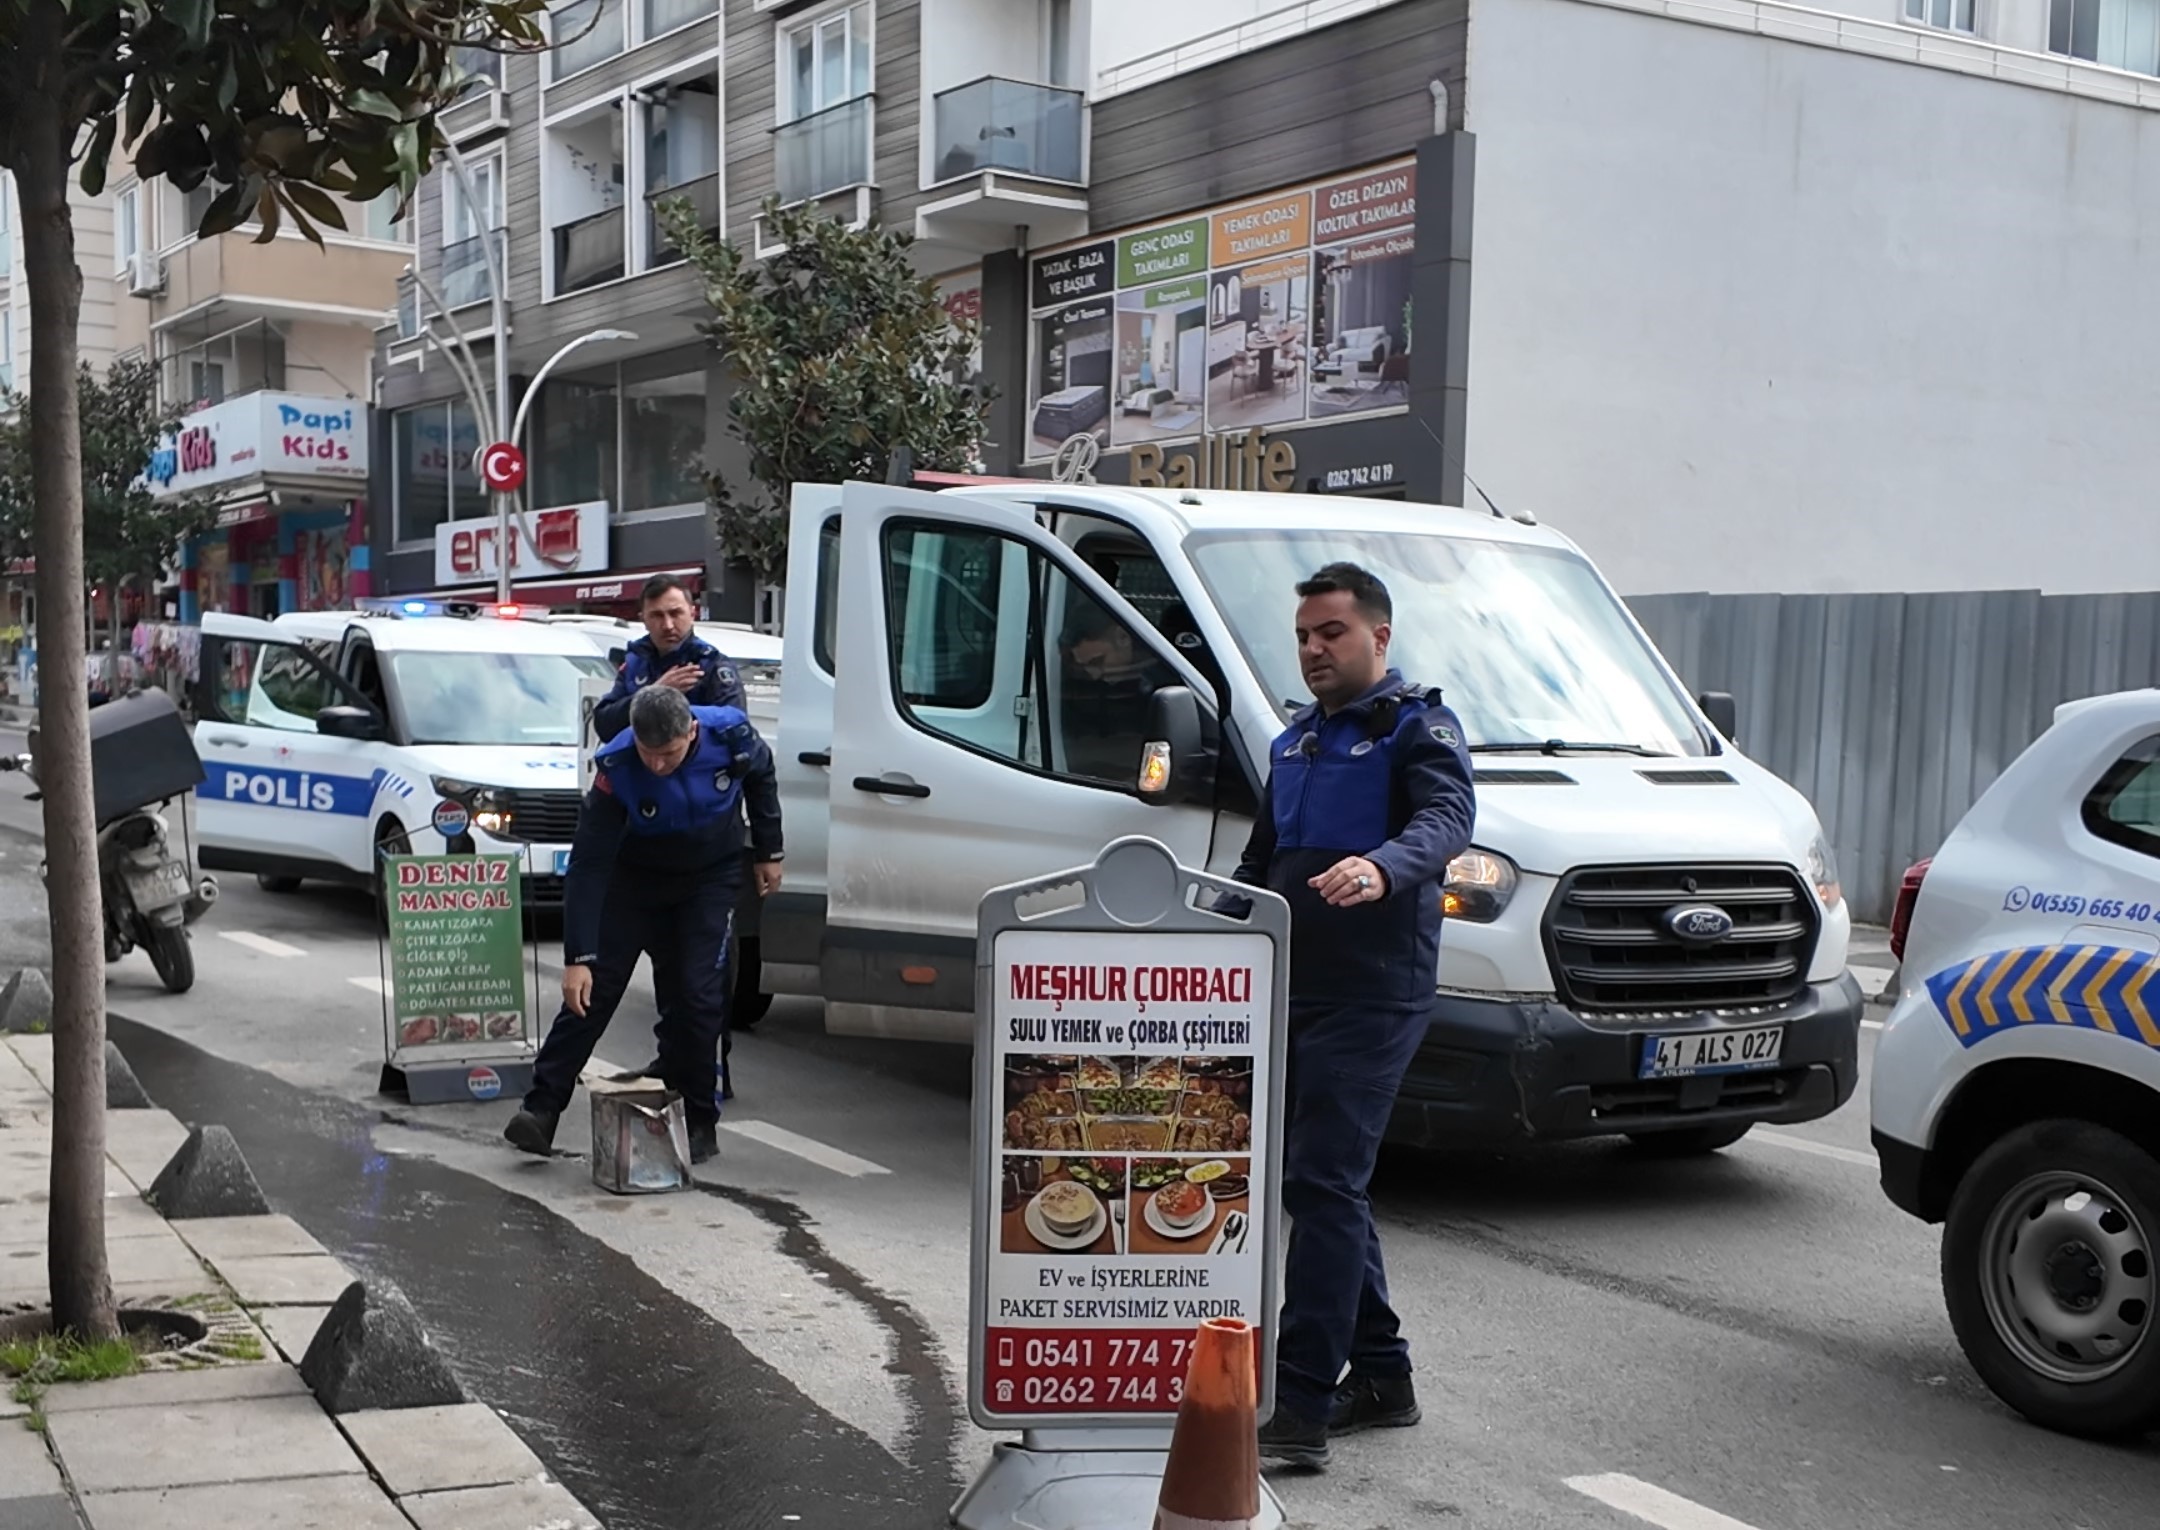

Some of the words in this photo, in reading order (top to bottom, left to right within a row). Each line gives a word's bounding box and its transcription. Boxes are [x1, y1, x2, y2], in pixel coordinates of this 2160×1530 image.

[1329, 190, 1359, 209] ÖZEL
[1362, 175, 1408, 199] DİZAYN
[1223, 214, 1261, 234] YEMEK
[1263, 203, 1299, 224] ODASI
[1317, 213, 1358, 236] KOLTUK
[1361, 198, 1416, 223] TAKIMLAR
[1130, 238, 1160, 257] GENÇ
[1160, 229, 1194, 250] ODASI
[1230, 228, 1290, 255] TAKIMLARI
[1041, 258, 1072, 278] YATAK
[1078, 251, 1105, 270] BAZA
[1134, 252, 1190, 277] TAKIMLARI
[1049, 281, 1062, 295] VE
[1063, 272, 1097, 294] BAŞLIK
[279, 404, 352, 434] Papi
[180, 426, 217, 473] Kids
[282, 435, 349, 460] Kids
[1129, 427, 1297, 492] Ballife
[1327, 470, 1350, 488] 0262
[225, 772, 334, 812] POLİS
[398, 857, 510, 886] DENİZ
[398, 889, 511, 911] MANGAL
[2030, 892, 2087, 917] 0(535)
[2089, 898, 2125, 918] 665
[2125, 903, 2151, 922] 40
[1688, 913, 1722, 933] Ford
[407, 966, 451, 979] ADANA
[1010, 964, 1127, 1012] MEŞHUR
[1133, 966, 1252, 1013] ÇORBACI
[1009, 1018, 1046, 1042] SULU
[1052, 1019, 1101, 1043] YEMEK
[1106, 1026, 1124, 1044] ve
[1128, 1020, 1178, 1050] ÇORBA
[1182, 1014, 1250, 1051] ÇEŞİTLERİ
[1656, 1040, 1682, 1069] 41
[1694, 1035, 1734, 1066] ALS
[1742, 1030, 1780, 1060] 027
[1039, 1269, 1063, 1287] EV
[1067, 1275, 1086, 1287] ve
[1091, 1265, 1210, 1291] İŞYERLERİNE
[1000, 1299, 1058, 1317] PAKET
[1174, 1299, 1245, 1317] VARDIR.
[1025, 1339, 1092, 1366] 0541
[1108, 1339, 1159, 1366] 774
[1024, 1377, 1095, 1404] 0262
[1106, 1377, 1157, 1403] 744
[1168, 1377, 1184, 1403] 3
